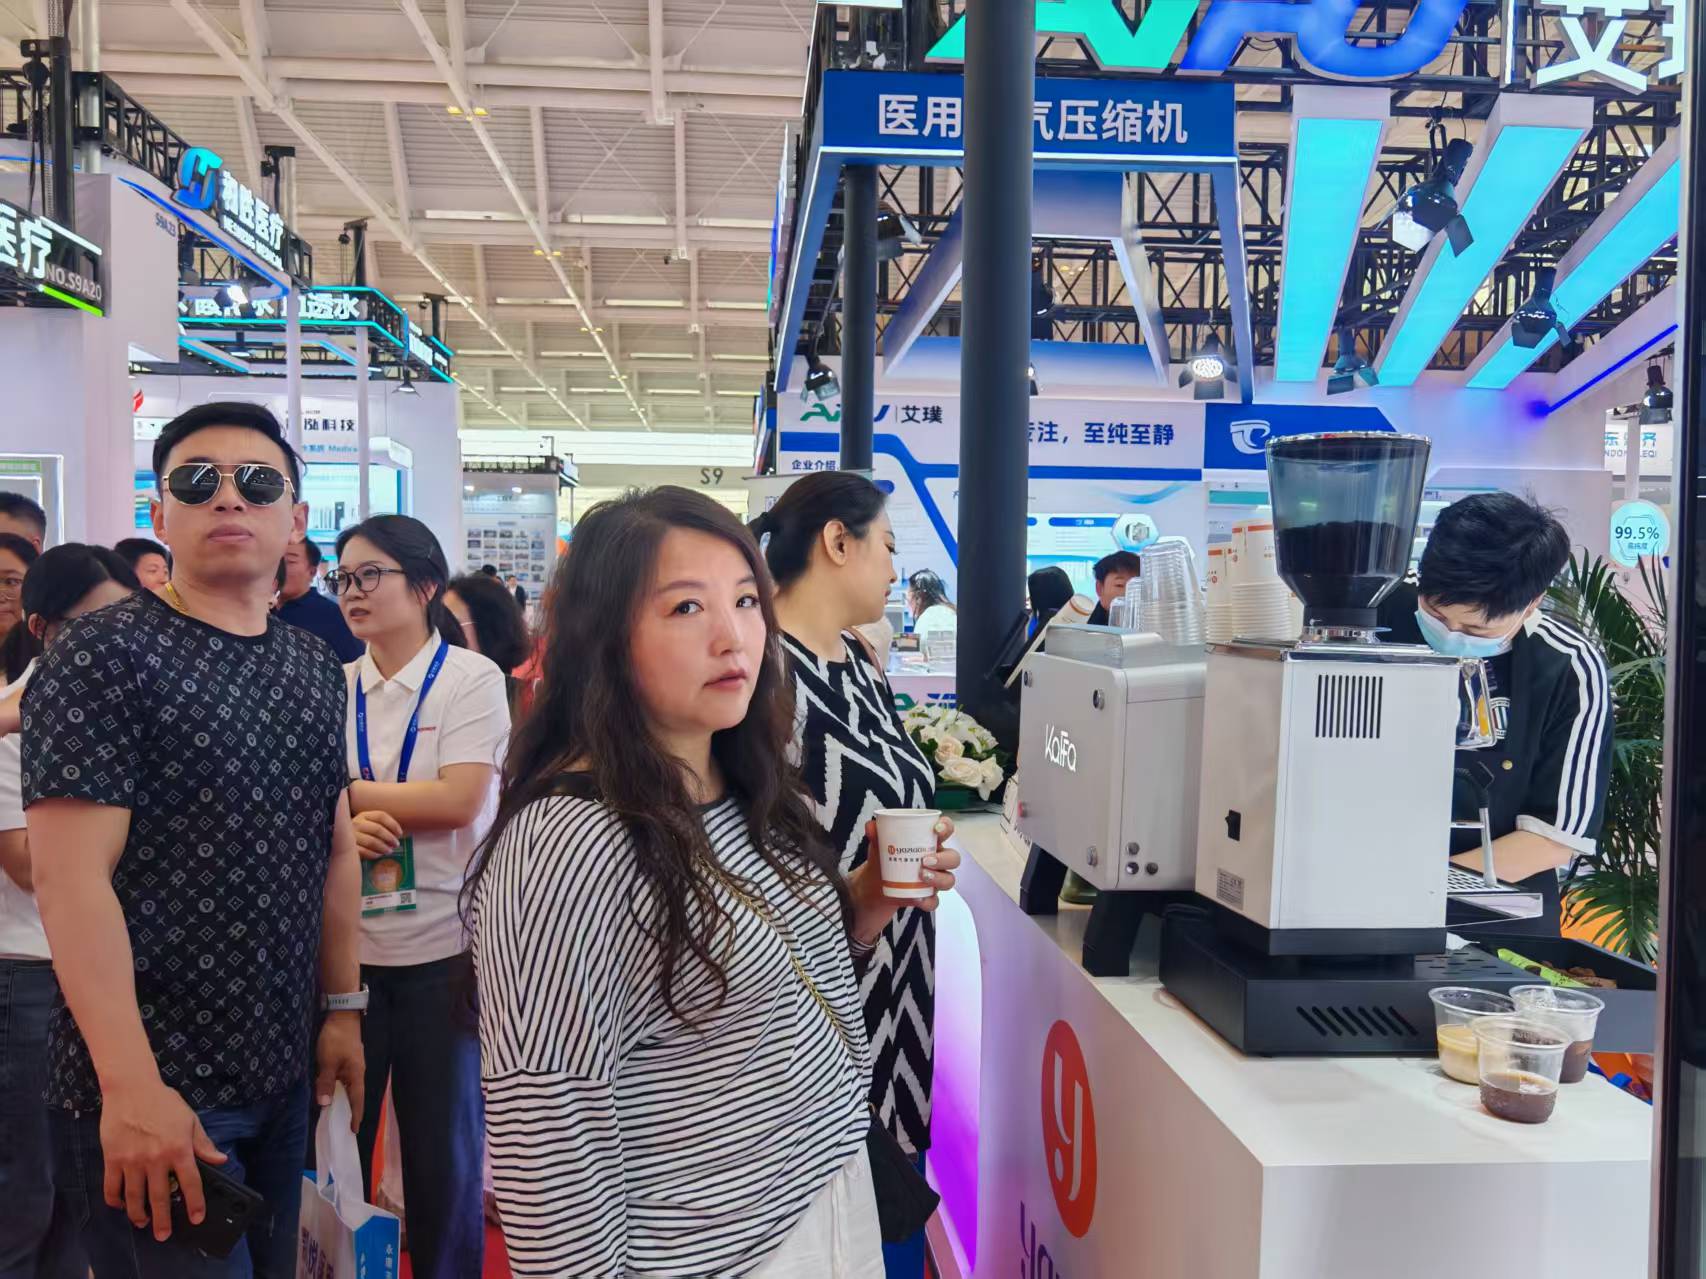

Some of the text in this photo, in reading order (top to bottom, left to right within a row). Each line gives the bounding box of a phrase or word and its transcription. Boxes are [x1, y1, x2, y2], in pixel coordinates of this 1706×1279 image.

[1535, 0, 1686, 95] 艾
[878, 94, 1188, 144] 医用气压缩机
[46, 263, 103, 301] NO.S9A20
[901, 405, 943, 424] 艾璞
[286, 418, 355, 431] 泓科技
[792, 460, 836, 471] 企业介绍
[700, 467, 723, 485] S9
[1615, 526, 1660, 540] 99.5%
